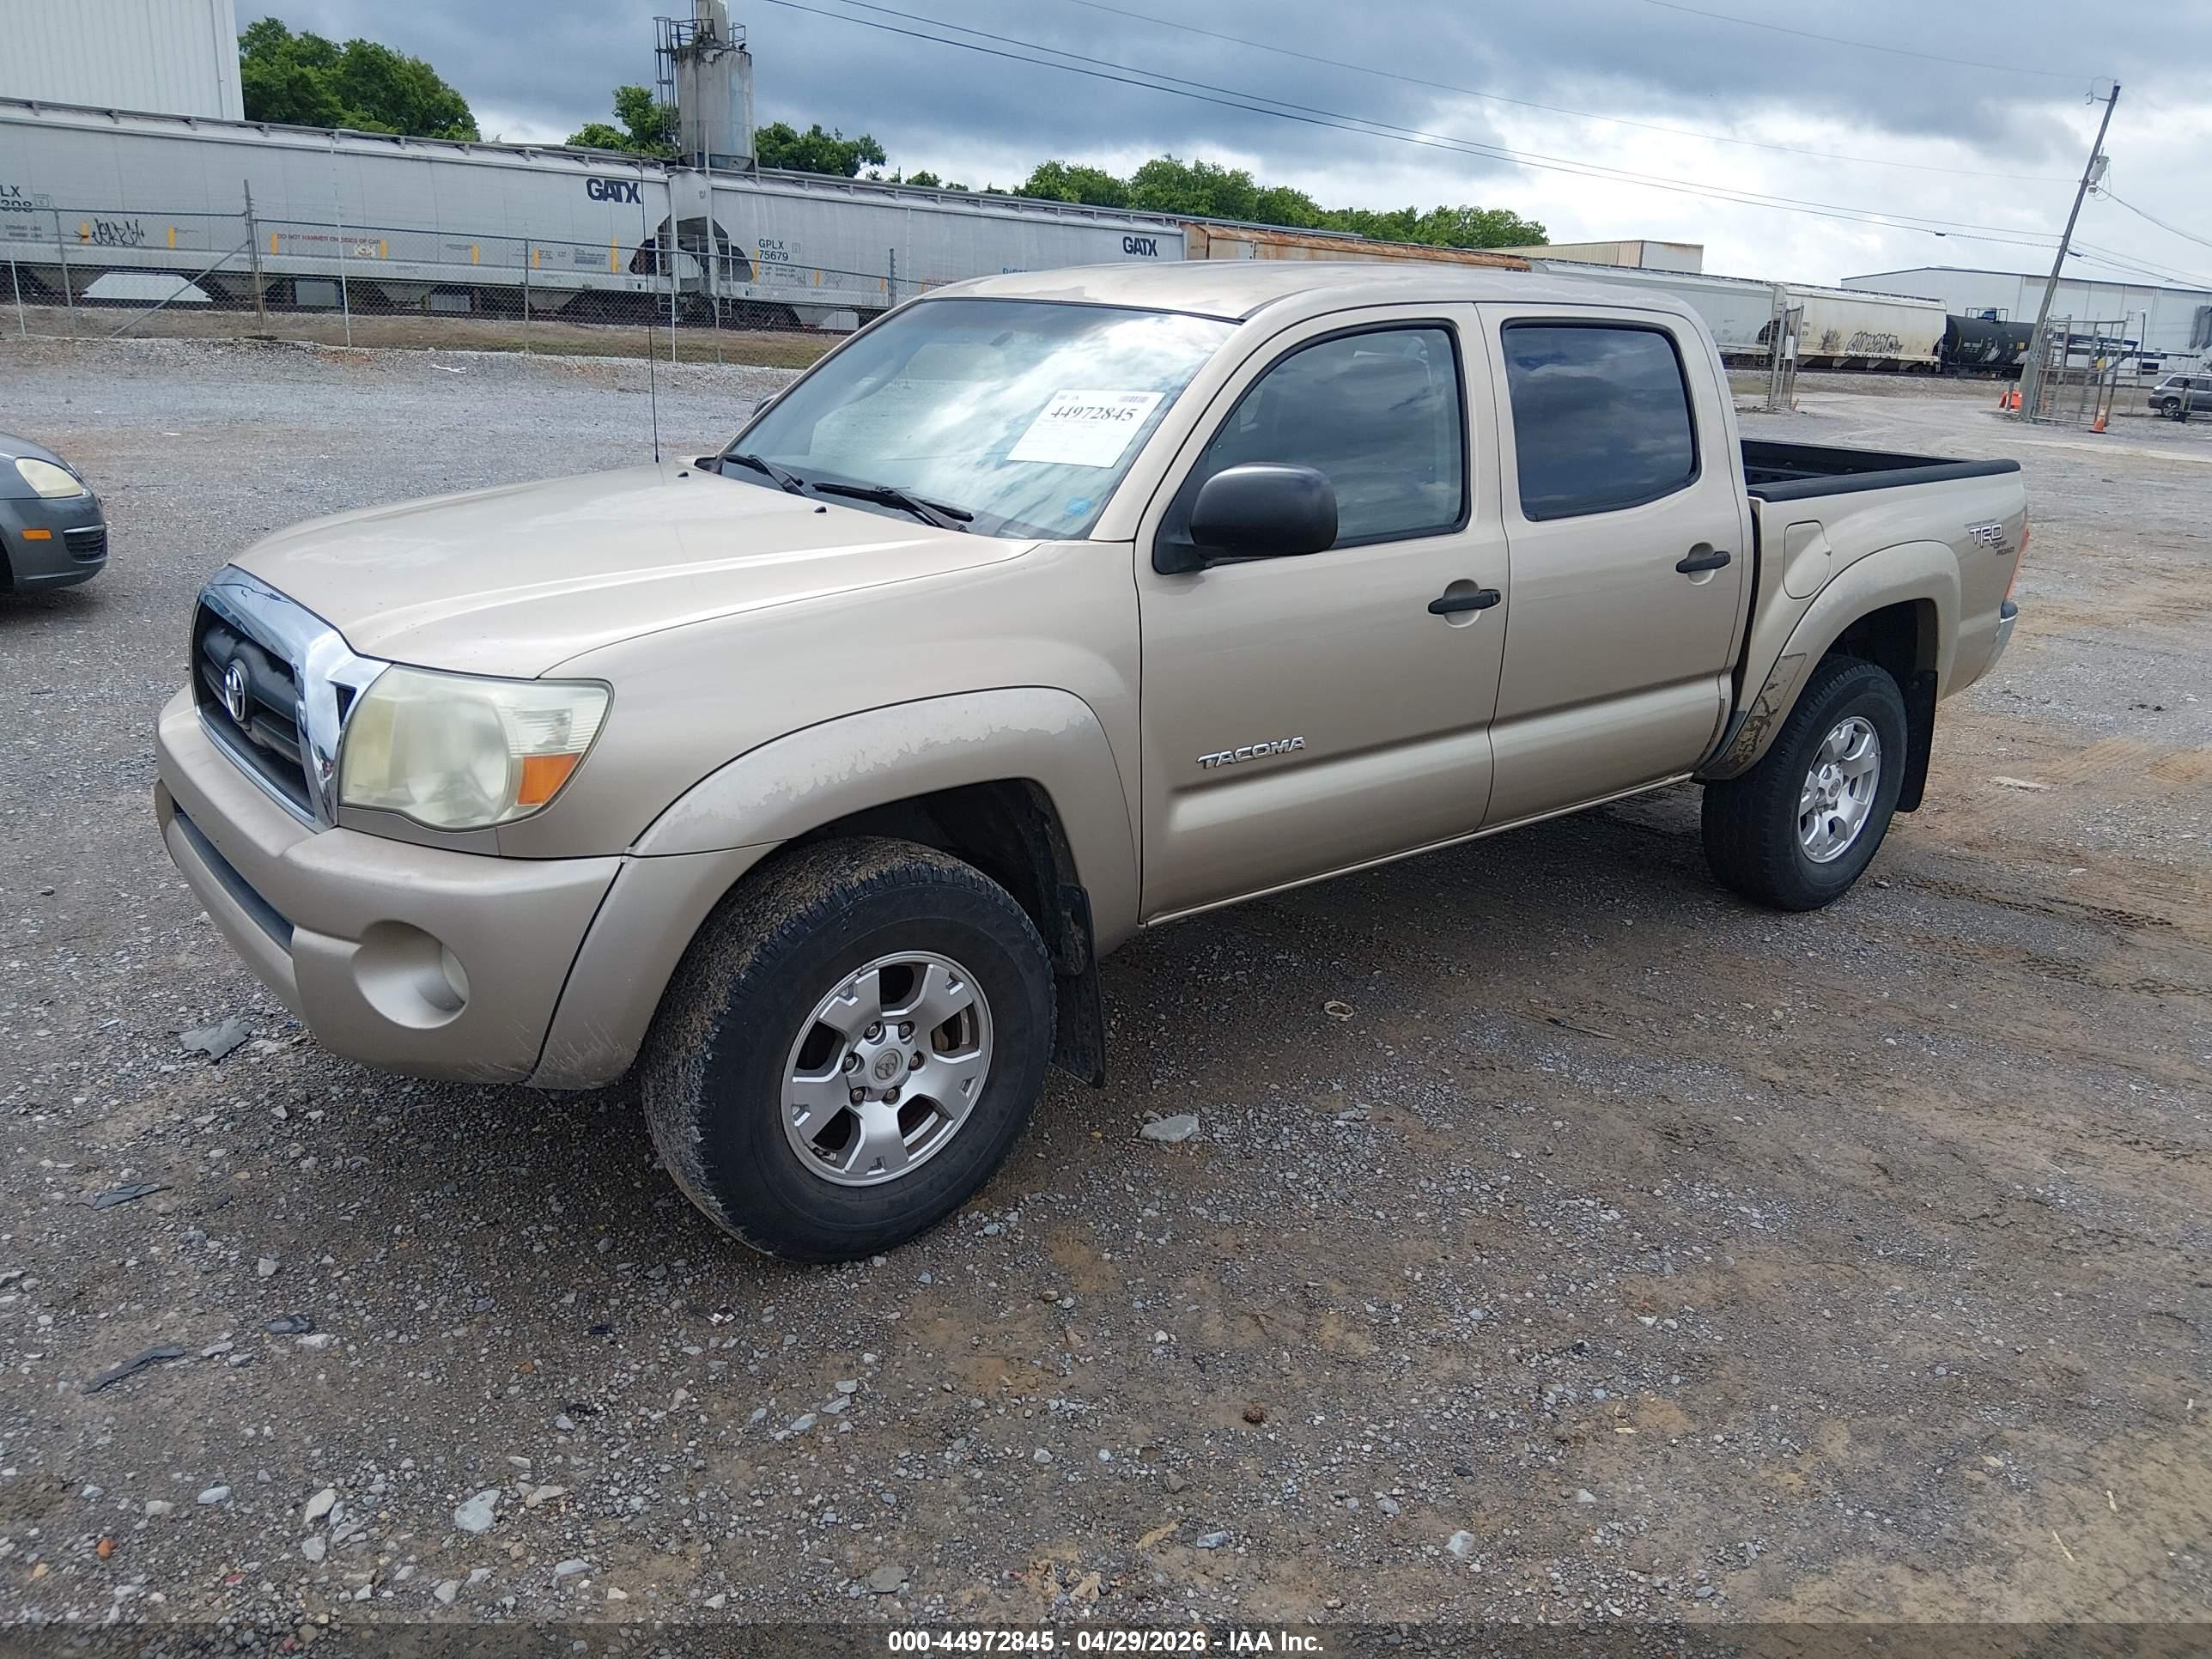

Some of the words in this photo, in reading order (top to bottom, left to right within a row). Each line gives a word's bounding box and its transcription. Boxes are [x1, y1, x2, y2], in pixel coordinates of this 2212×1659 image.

[586, 178, 641, 204] GATX
[758, 239, 784, 250] GPLX
[1122, 236, 1158, 257] GATX
[759, 250, 788, 261] 75679
[1051, 405, 1138, 421] 44972845
[1969, 524, 2002, 549] TRD
[1996, 546, 2014, 556] ROAD
[1196, 736, 1305, 768] TACOMA
